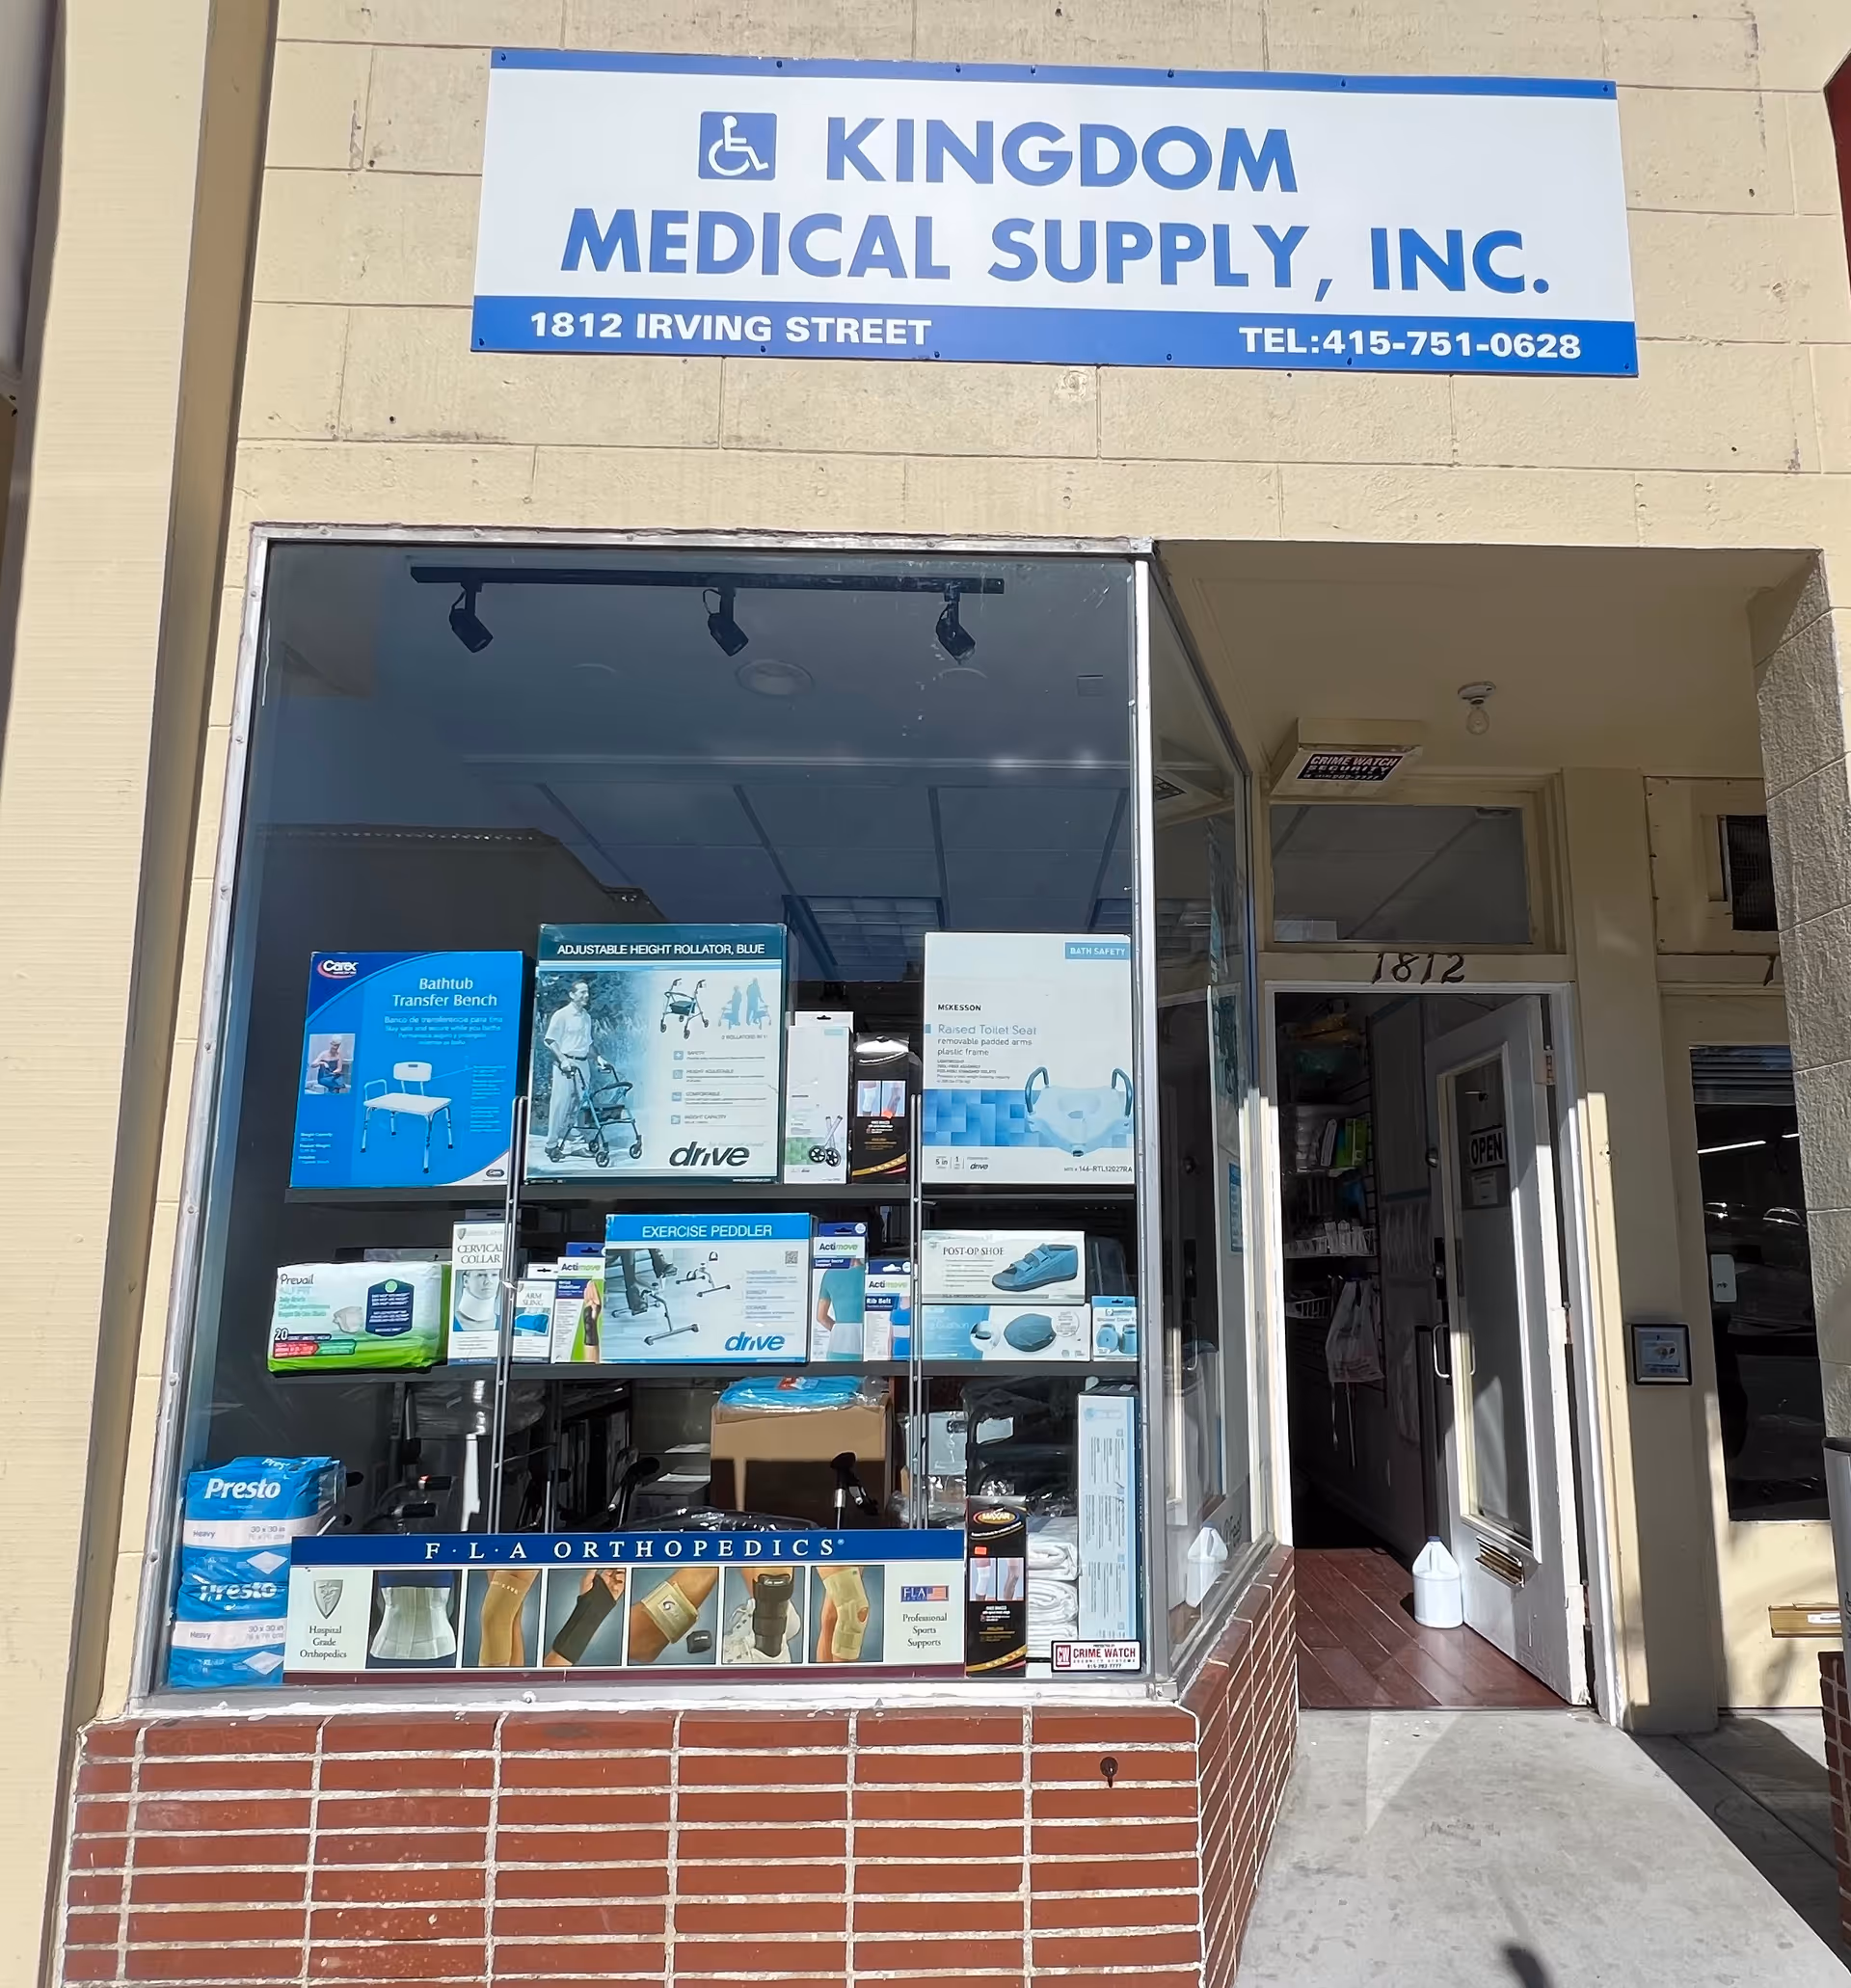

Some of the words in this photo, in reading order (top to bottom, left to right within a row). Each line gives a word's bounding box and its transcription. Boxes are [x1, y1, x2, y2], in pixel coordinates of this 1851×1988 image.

[826, 116, 1299, 193] KINGDOM
[560, 207, 951, 280] MEDICAL
[987, 218, 1333, 302] SUPPLY,
[1370, 228, 1549, 294] INC.
[531, 311, 623, 337] 1812
[636, 312, 772, 341] IRVING
[786, 315, 932, 345] STREET
[1310, 755, 1352, 766] CRIME
[1353, 756, 1398, 766] WATCH
[557, 944, 627, 954] ADJUSTABLE
[630, 944, 671, 954] HEIGHT
[675, 944, 734, 955] ROLLATOR,
[737, 943, 765, 954] BLUE
[1069, 947, 1092, 955] BATH
[1371, 952, 1465, 985] 1812
[418, 977, 474, 990] Bathtub
[392, 993, 449, 1007] Transfer
[453, 993, 497, 1007] Bench
[938, 1024, 977, 1034] Raised
[979, 1024, 1009, 1035] Toilet
[1011, 1025, 1037, 1035] Seat
[980, 1038, 1009, 1047] padded
[937, 1048, 963, 1057] plastic
[669, 1141, 750, 1167] drive
[1470, 1132, 1504, 1166] OPEN
[642, 1225, 708, 1238] EXERCISE
[711, 1224, 772, 1237] PEDDLER
[457, 1244, 503, 1254] CERVICAL
[943, 1247, 979, 1255] POST-OP
[461, 1254, 501, 1264] COLLAR
[281, 1274, 314, 1284] Prevail
[274, 1329, 288, 1341] 20
[725, 1331, 786, 1352] drive
[204, 1478, 282, 1499] Presto
[193, 1530, 216, 1539] Heavy
[903, 1587, 926, 1598] FLA
[902, 1612, 948, 1622] Professional
[309, 1625, 342, 1636] Hospital
[912, 1625, 937, 1636] Sports
[312, 1637, 336, 1646] Grade
[907, 1638, 942, 1649] Supports
[300, 1649, 347, 1660] Orthopedics
[1073, 1648, 1101, 1658] CRIME
[1104, 1647, 1136, 1657] WATCH
